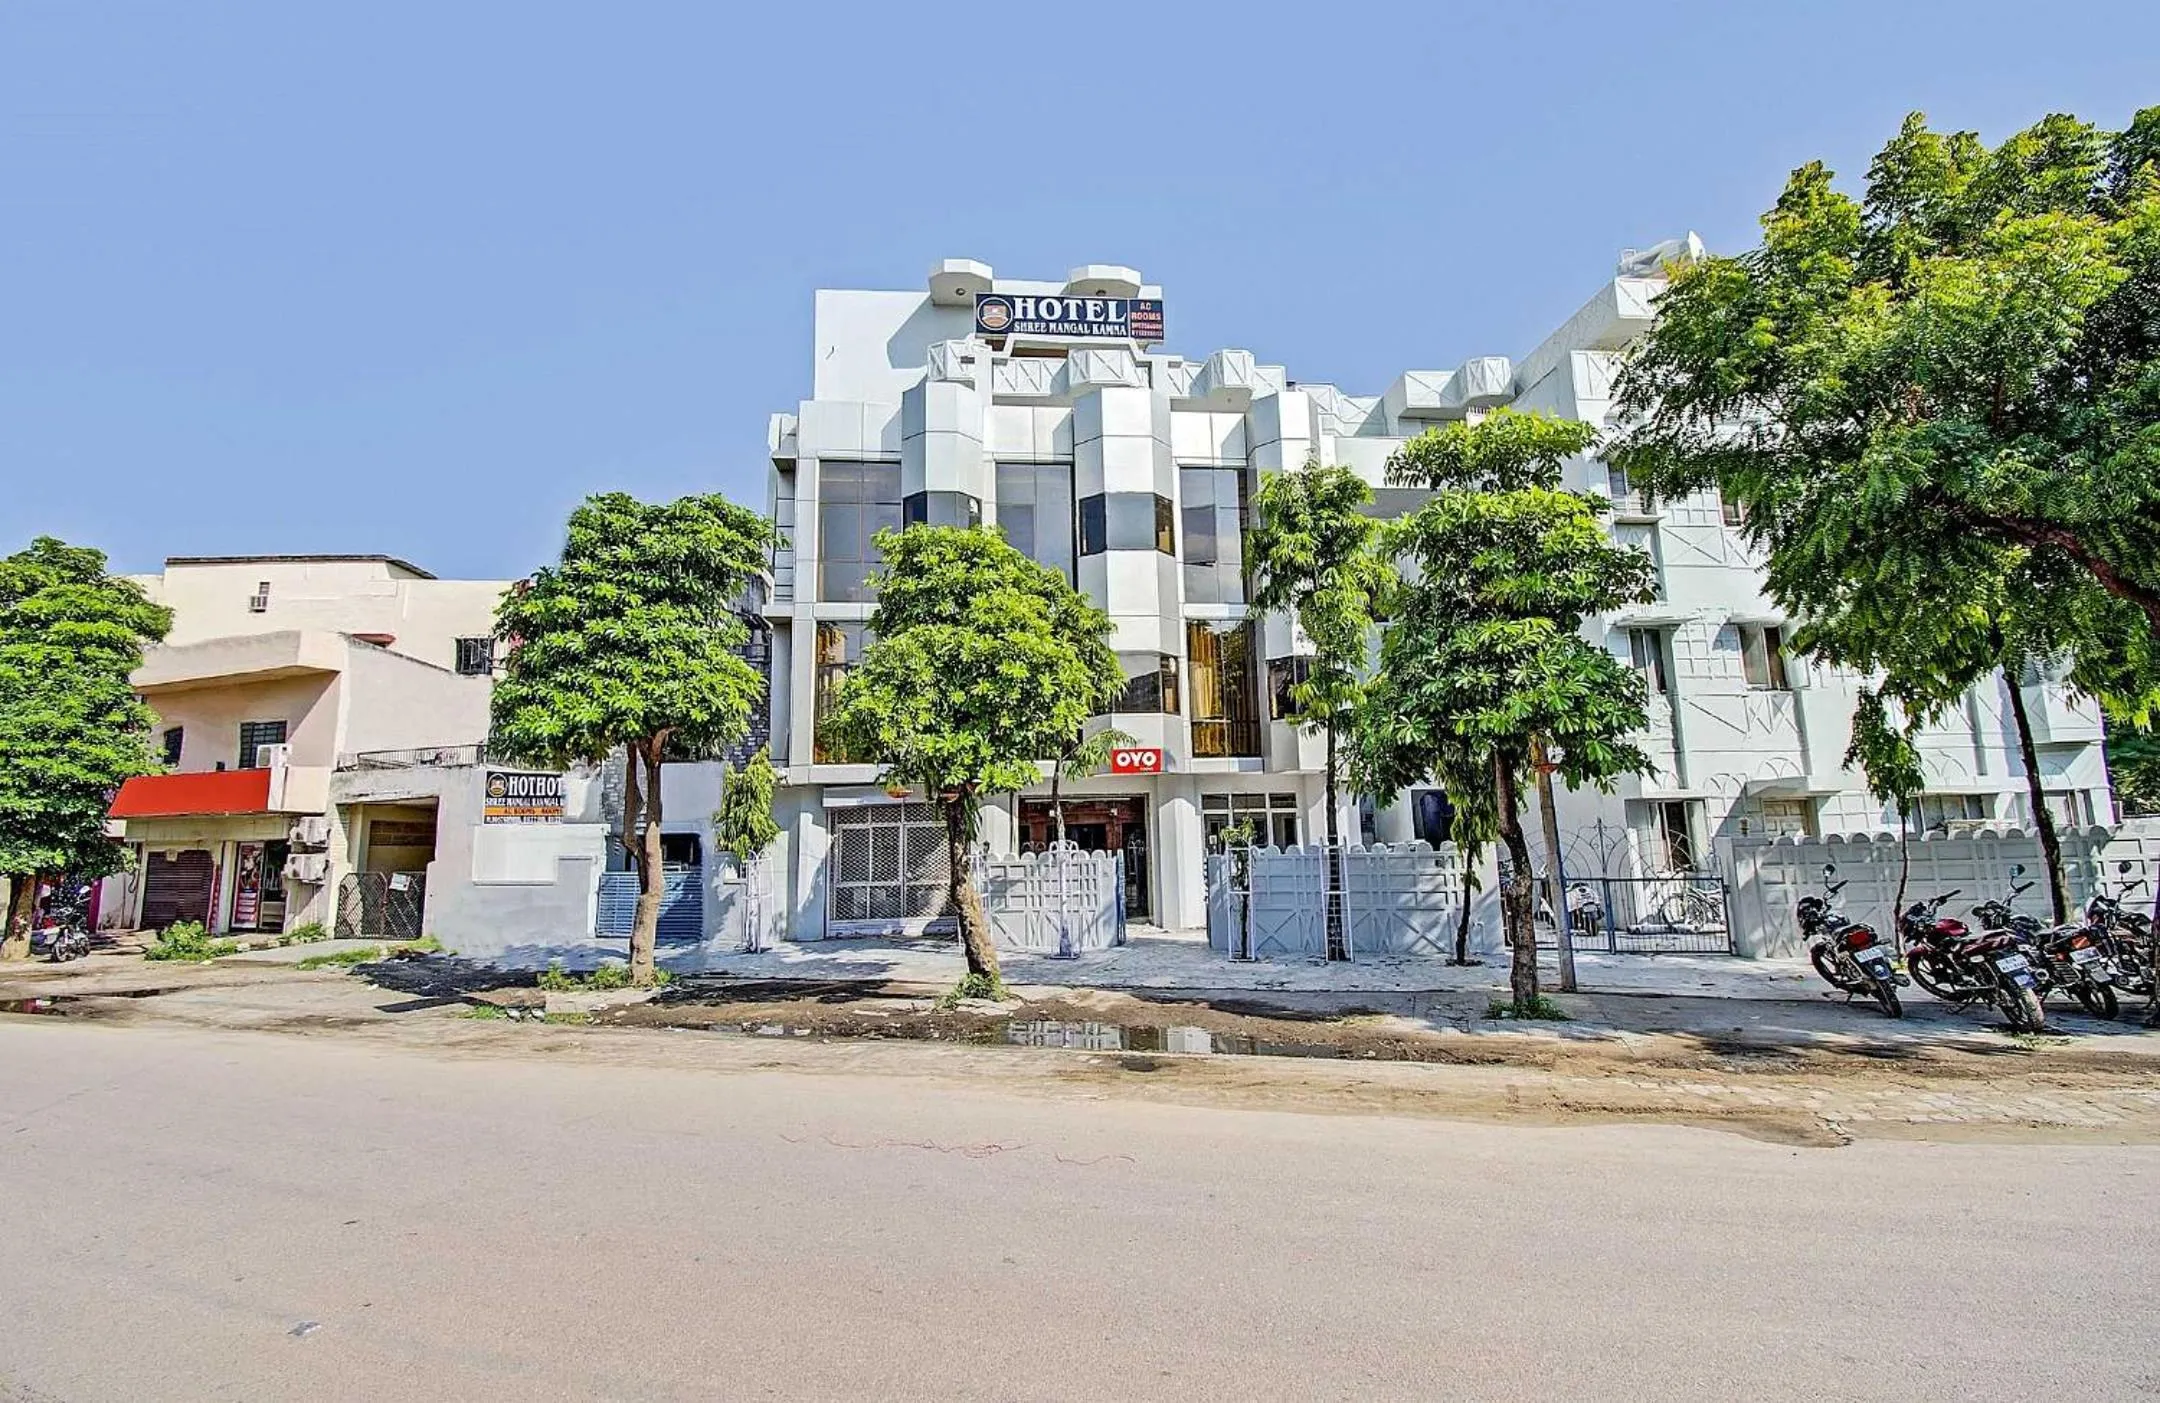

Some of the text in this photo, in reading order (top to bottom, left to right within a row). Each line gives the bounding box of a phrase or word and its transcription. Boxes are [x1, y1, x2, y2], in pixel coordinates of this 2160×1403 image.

[1013, 297, 1127, 322] HOTEL
[1131, 312, 1161, 321] ROOMS
[1013, 321, 1048, 333] SHREE
[1049, 322, 1091, 335] MANGAL
[1092, 324, 1127, 336] KAMNA
[1116, 751, 1157, 768] OYO
